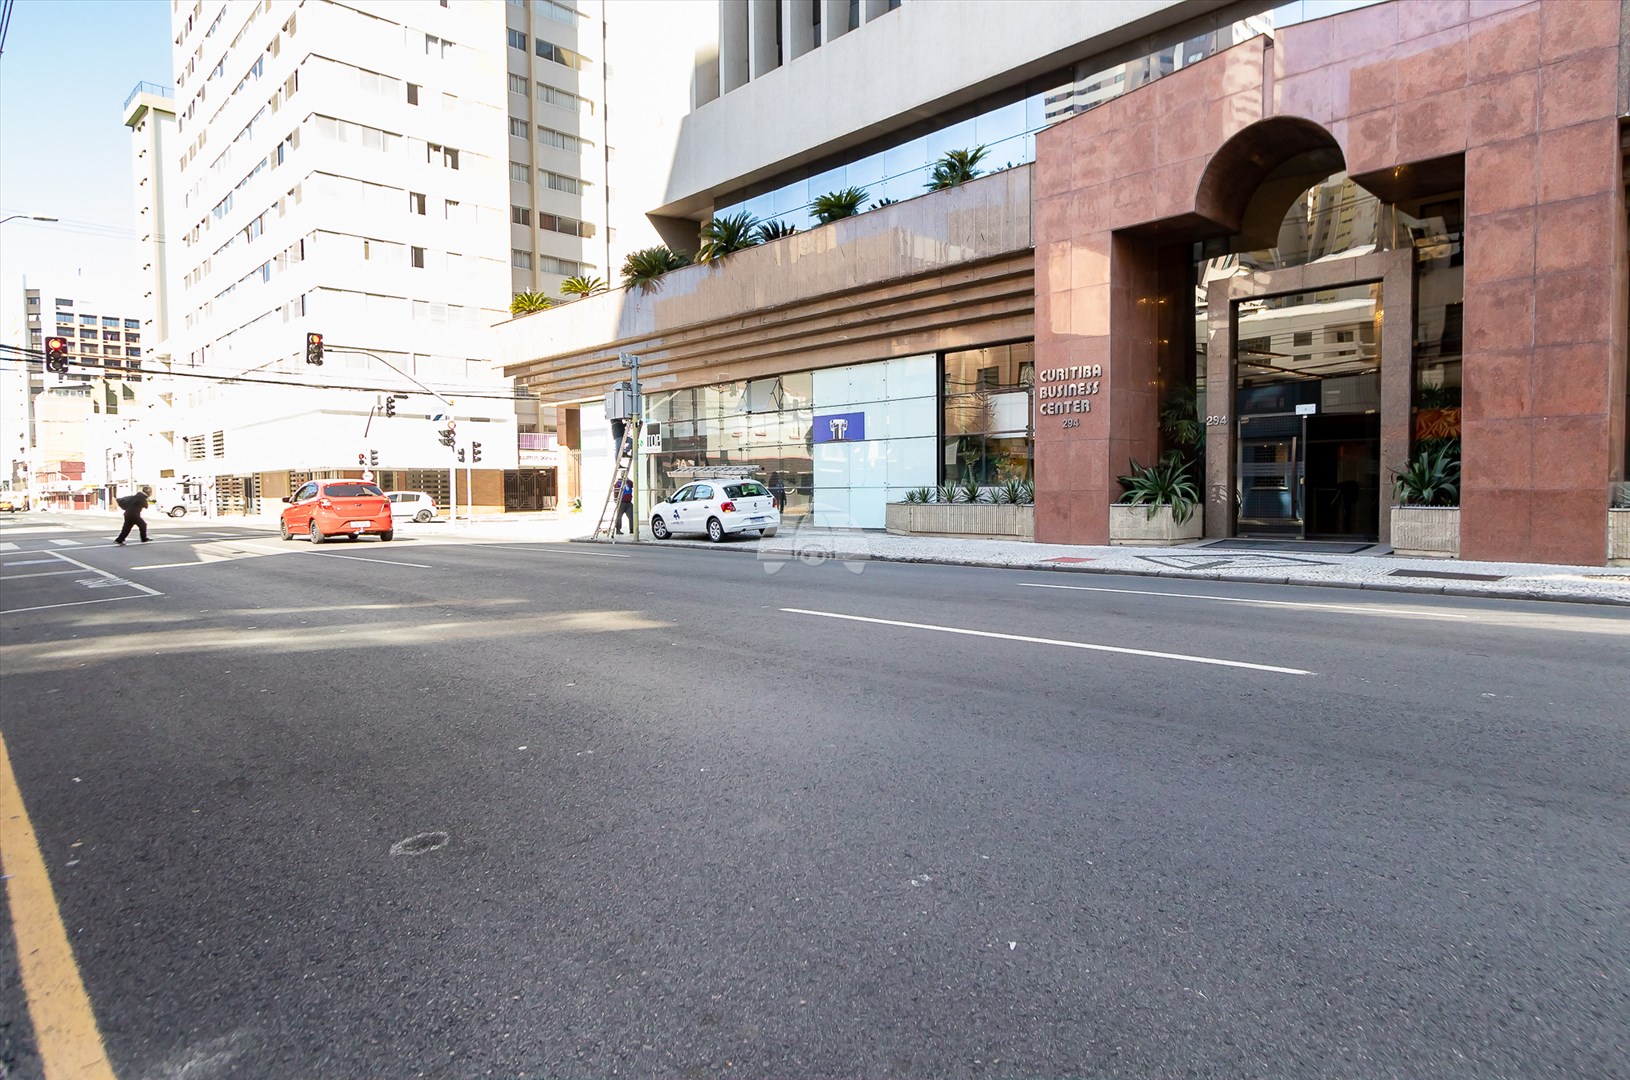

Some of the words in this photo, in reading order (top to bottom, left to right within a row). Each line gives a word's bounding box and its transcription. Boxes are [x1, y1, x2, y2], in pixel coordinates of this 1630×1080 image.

[1039, 363, 1102, 383] CURITIBA
[1039, 381, 1100, 400] BUSINESS
[1039, 399, 1091, 416] CENTER
[1062, 418, 1081, 429] 294
[1206, 415, 1228, 426] 294
